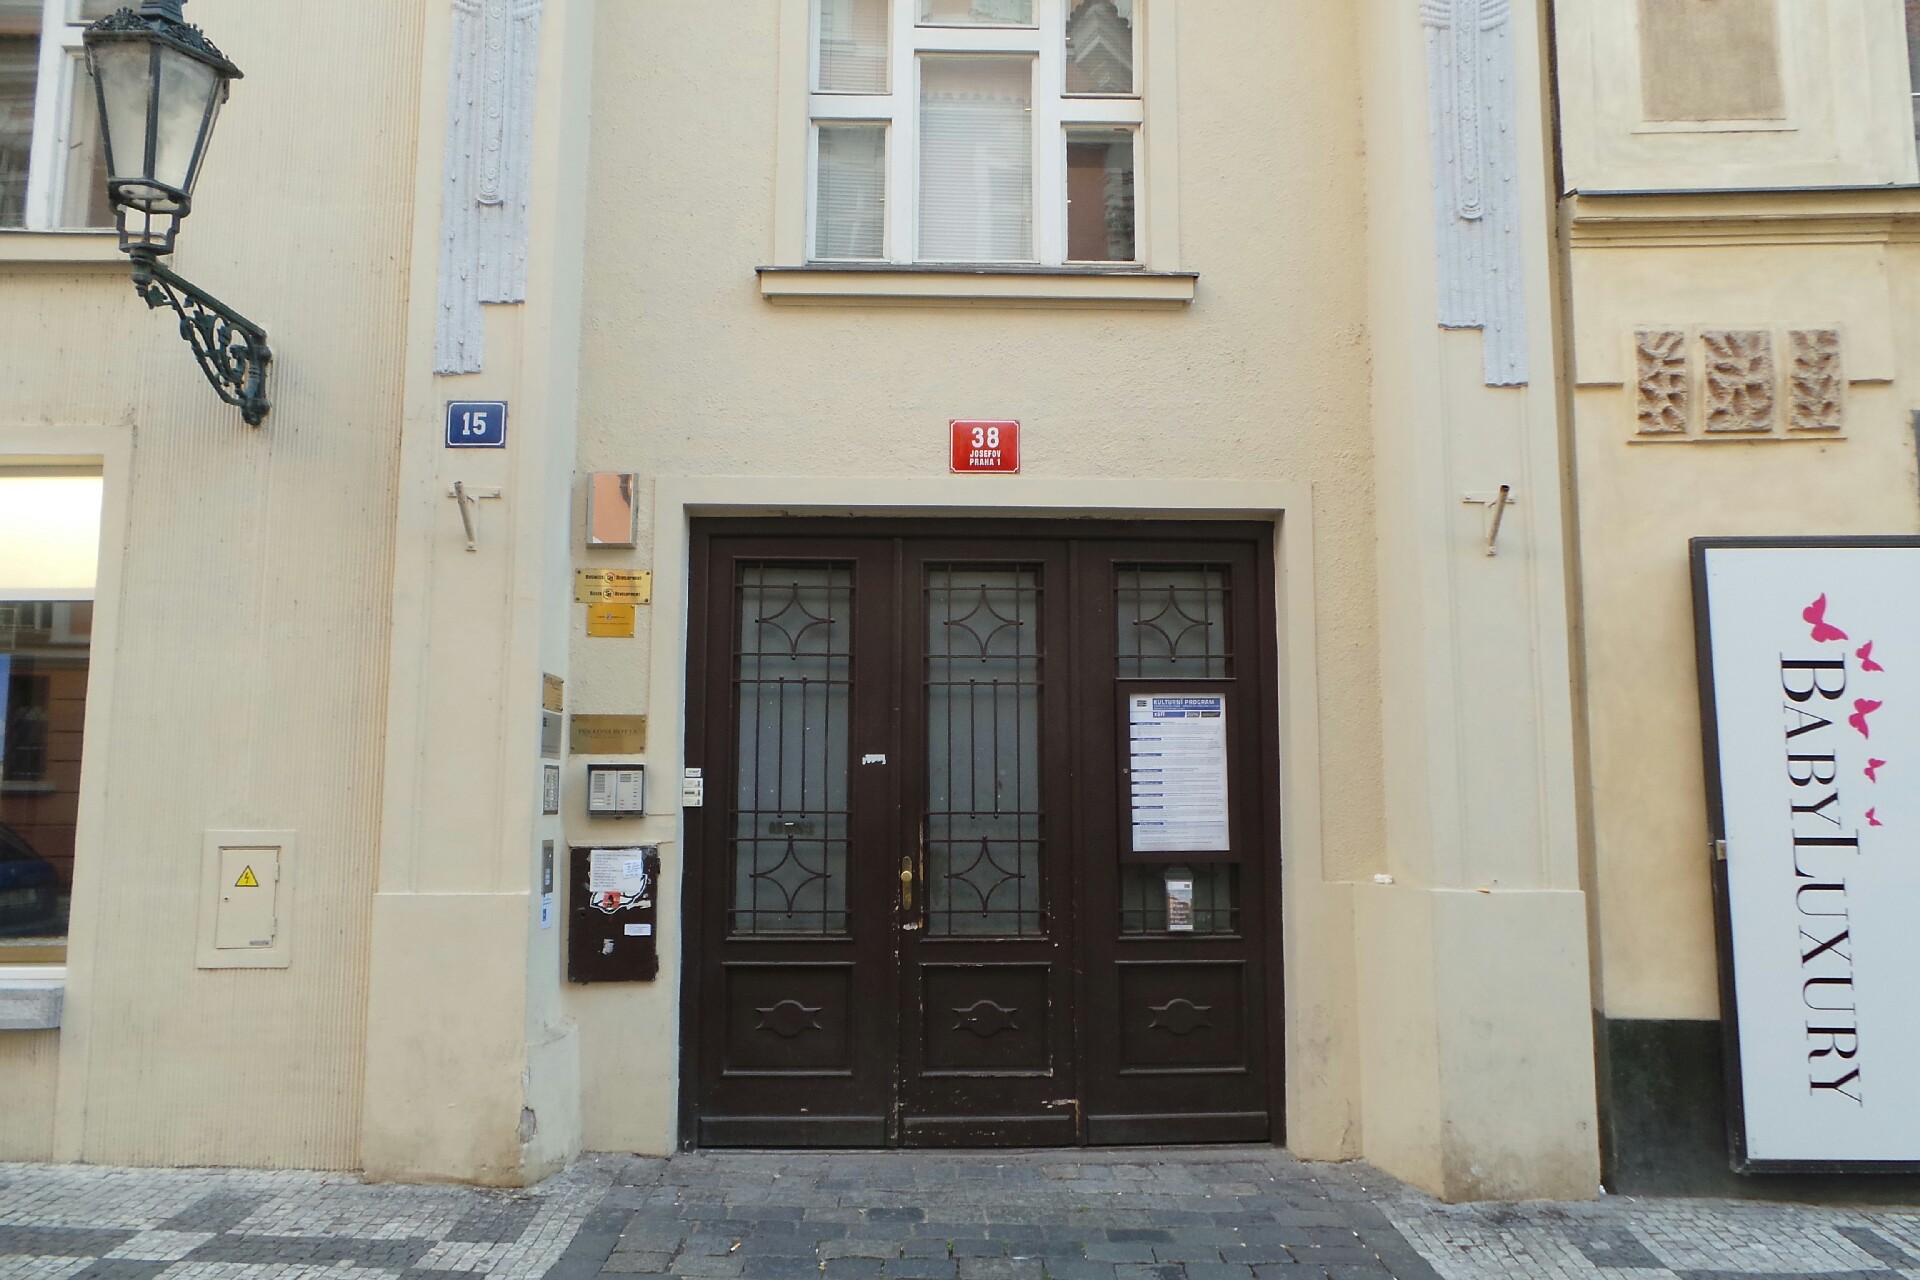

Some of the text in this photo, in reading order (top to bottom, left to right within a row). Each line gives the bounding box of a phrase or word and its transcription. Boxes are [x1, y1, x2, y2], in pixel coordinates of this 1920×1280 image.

[462, 411, 488, 436] 15
[971, 426, 1000, 449] 38
[969, 449, 1001, 458] JOSEFOV
[969, 458, 1001, 466] PRAHA 1
[1779, 651, 1863, 1108] BABYLUXURY
